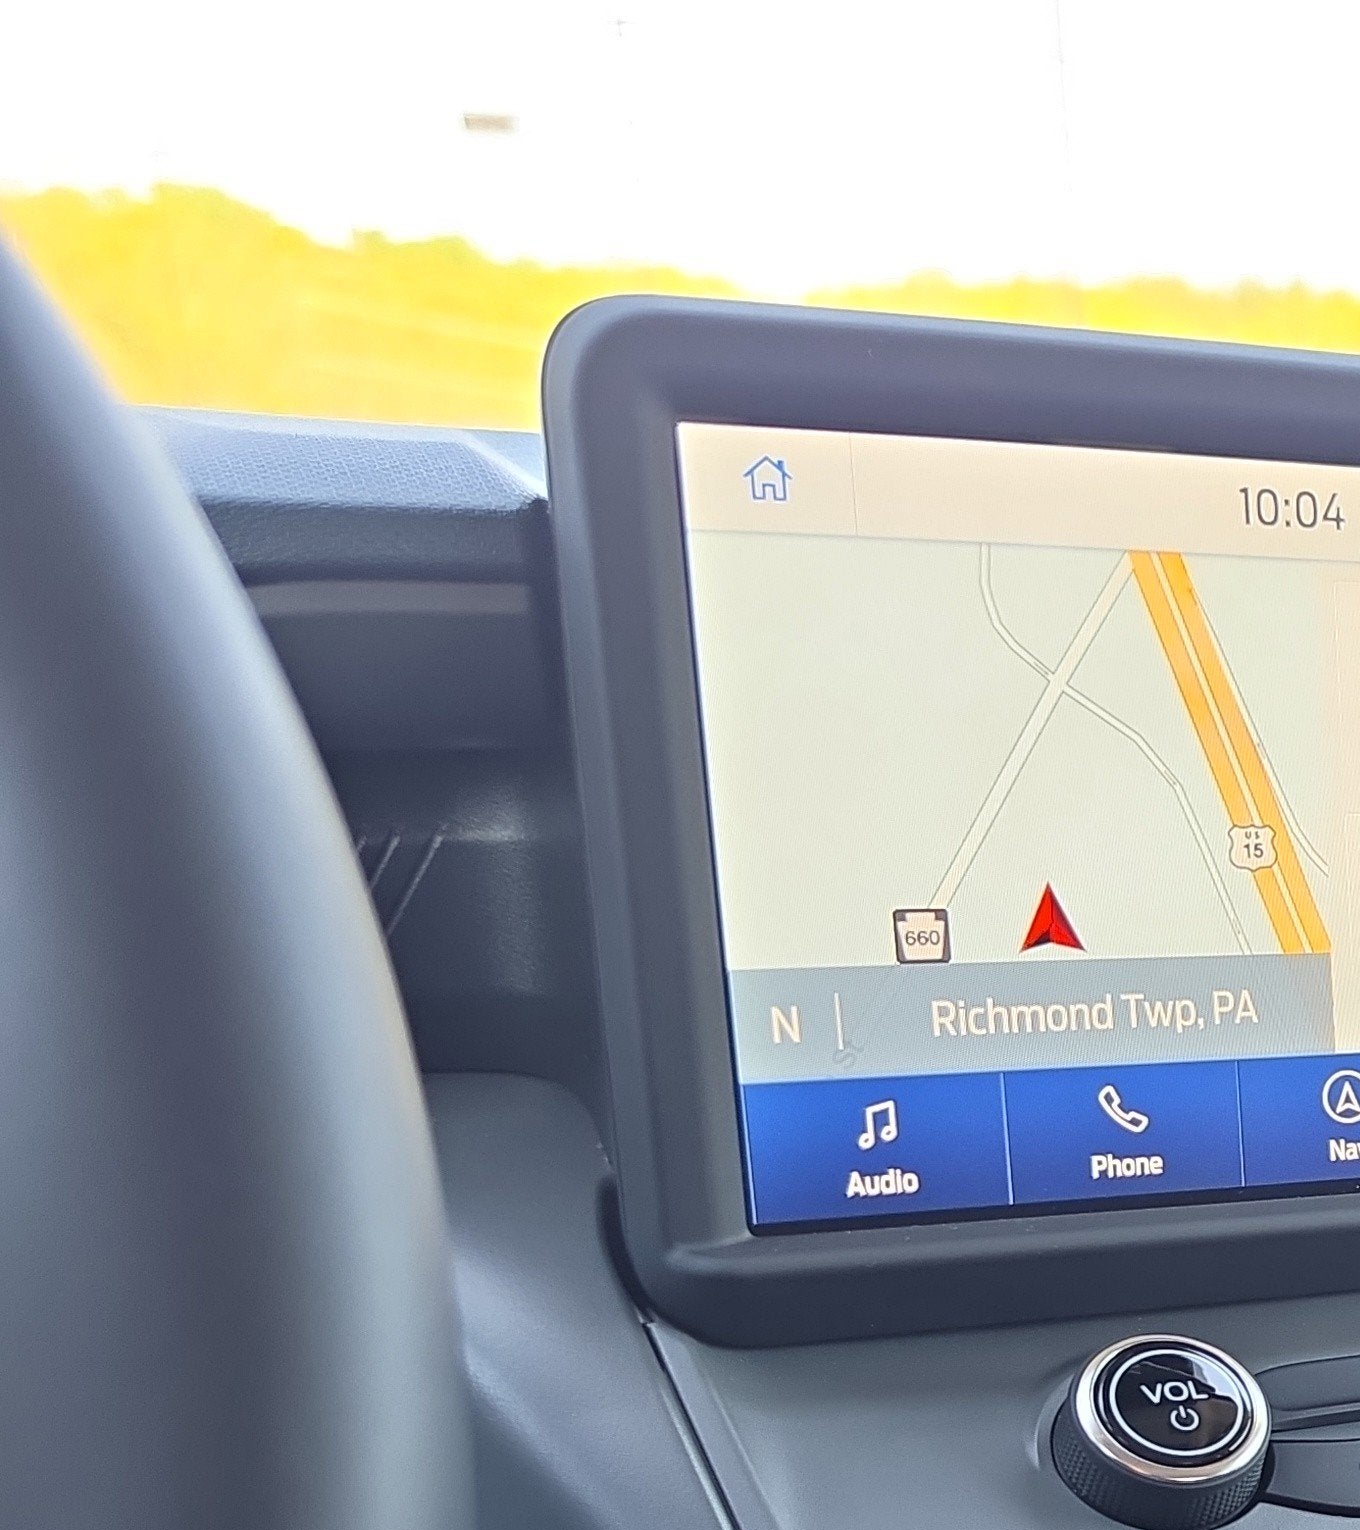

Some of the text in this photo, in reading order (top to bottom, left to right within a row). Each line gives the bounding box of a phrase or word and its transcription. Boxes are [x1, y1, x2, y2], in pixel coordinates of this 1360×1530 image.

[1238, 486, 1345, 531] 10:04
[1243, 842, 1264, 859] 15
[904, 929, 941, 947] 660
[769, 1005, 801, 1045] N
[930, 988, 1260, 1038] Richmond Twp, PA
[1090, 1152, 1164, 1180] Phone
[845, 1167, 920, 1198] Audio
[1139, 1379, 1210, 1405] VOL
